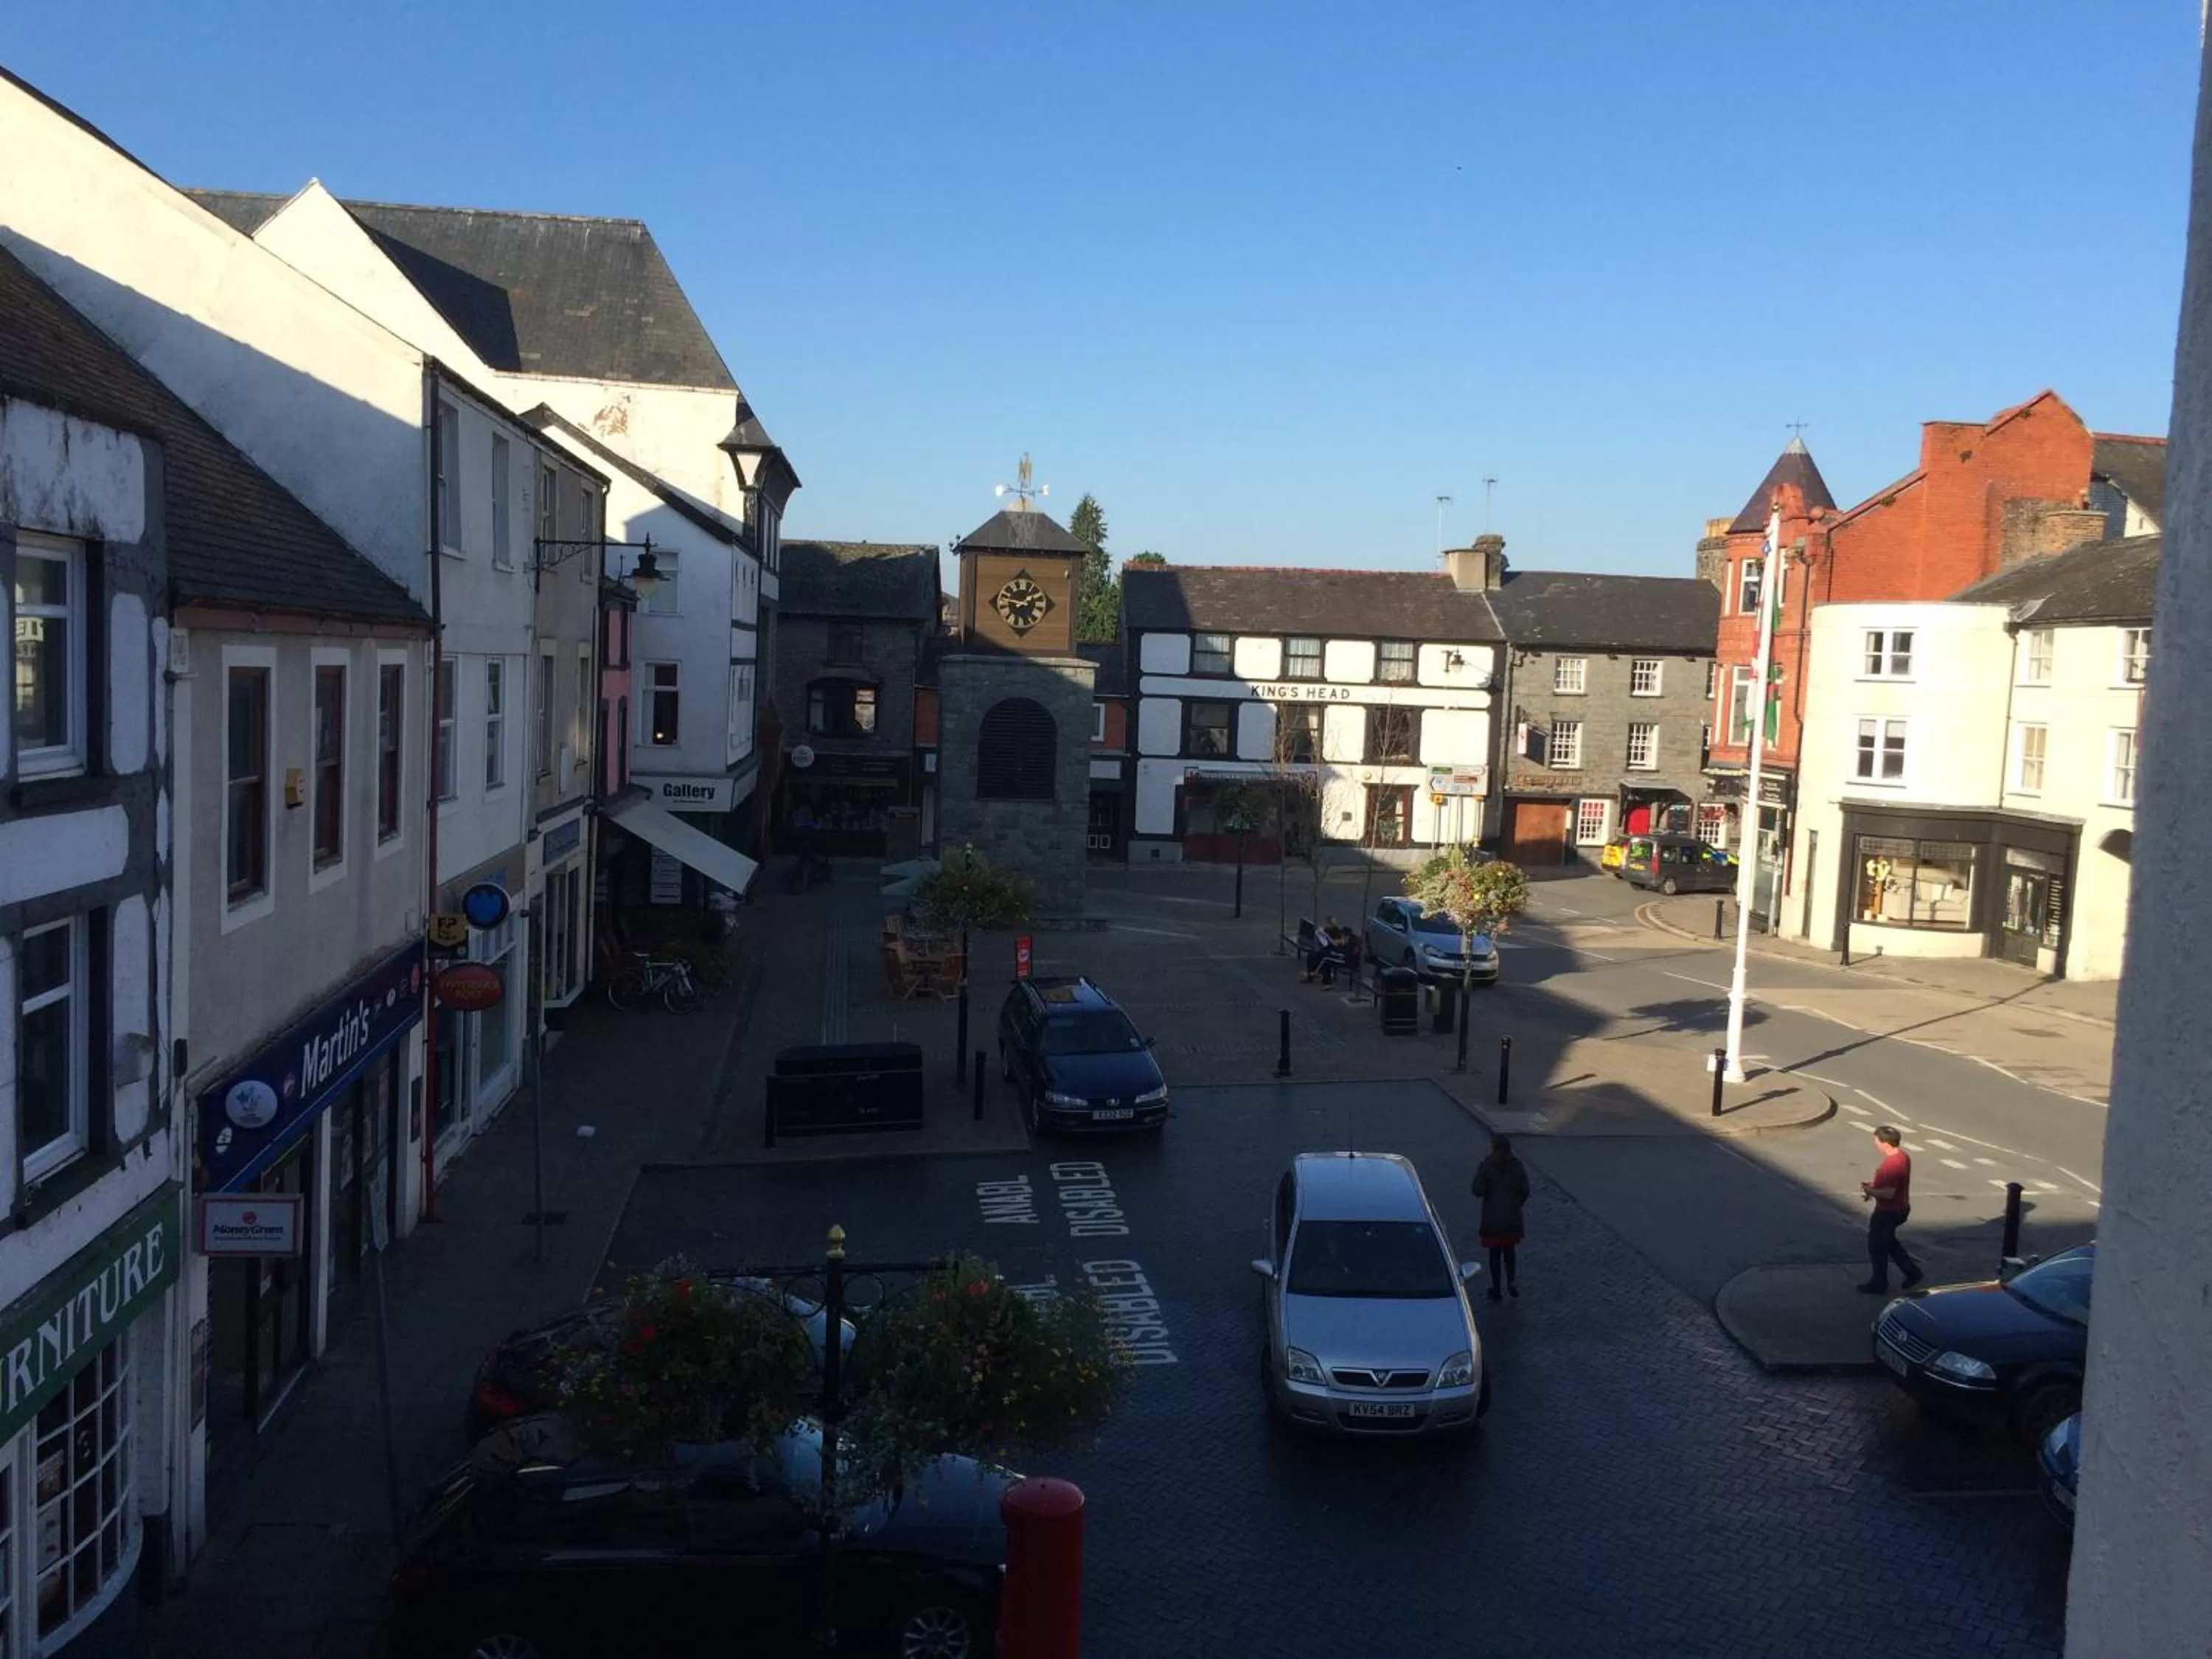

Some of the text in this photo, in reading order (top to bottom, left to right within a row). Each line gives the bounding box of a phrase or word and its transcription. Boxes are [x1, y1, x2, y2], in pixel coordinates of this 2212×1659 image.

[1251, 685, 1350, 700] KING'S HEAD
[663, 783, 715, 800] Gallery
[299, 998, 370, 1099] Martin's
[1049, 1161, 1130, 1237] DISABLED
[0, 1221, 165, 1414] RNITURE
[1082, 1259, 1180, 1364] DISABLED
